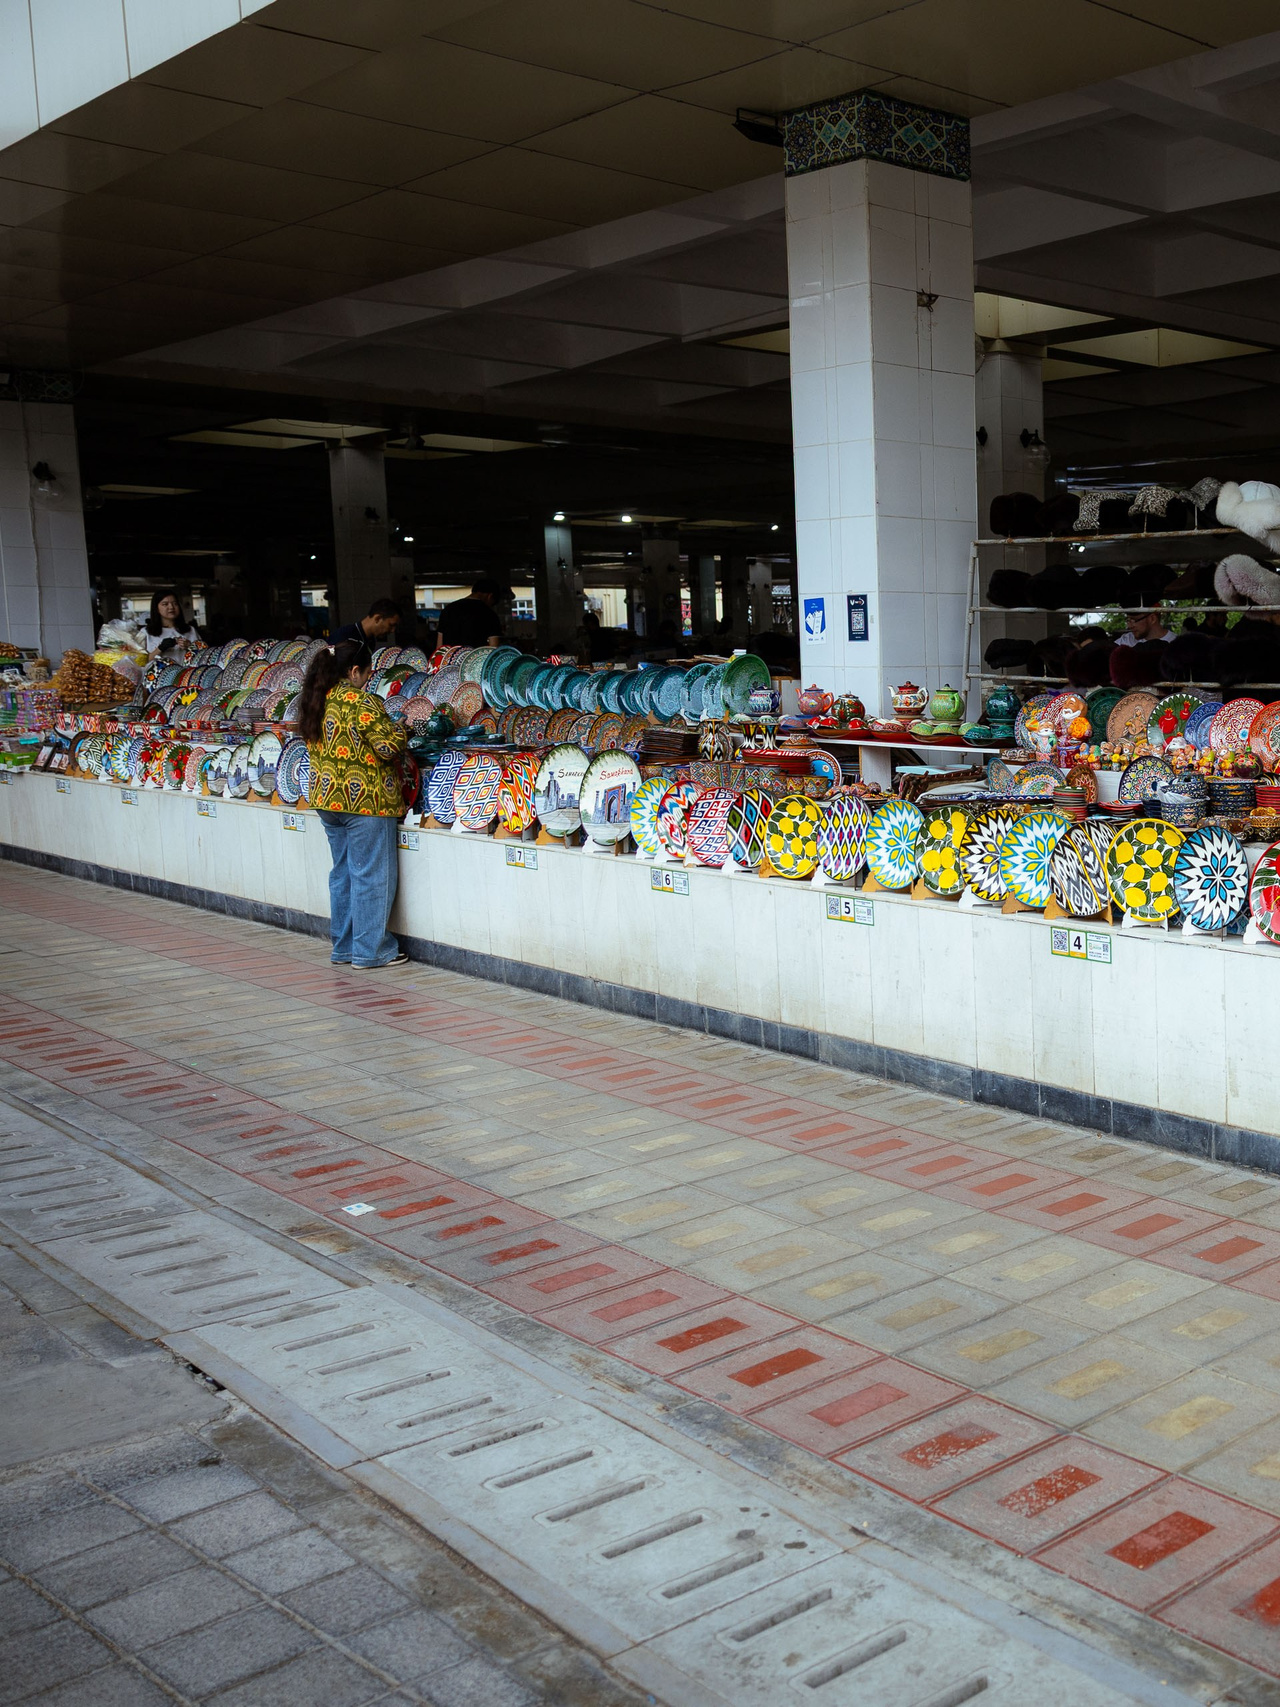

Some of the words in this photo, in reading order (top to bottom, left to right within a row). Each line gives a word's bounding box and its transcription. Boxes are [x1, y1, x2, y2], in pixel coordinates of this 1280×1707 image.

[291, 816, 294, 825] 9
[402, 834, 407, 843] 8
[517, 850, 522, 861] 7
[665, 874, 670, 885] 6
[844, 902, 850, 914] 5
[1074, 936, 1082, 950] 4
